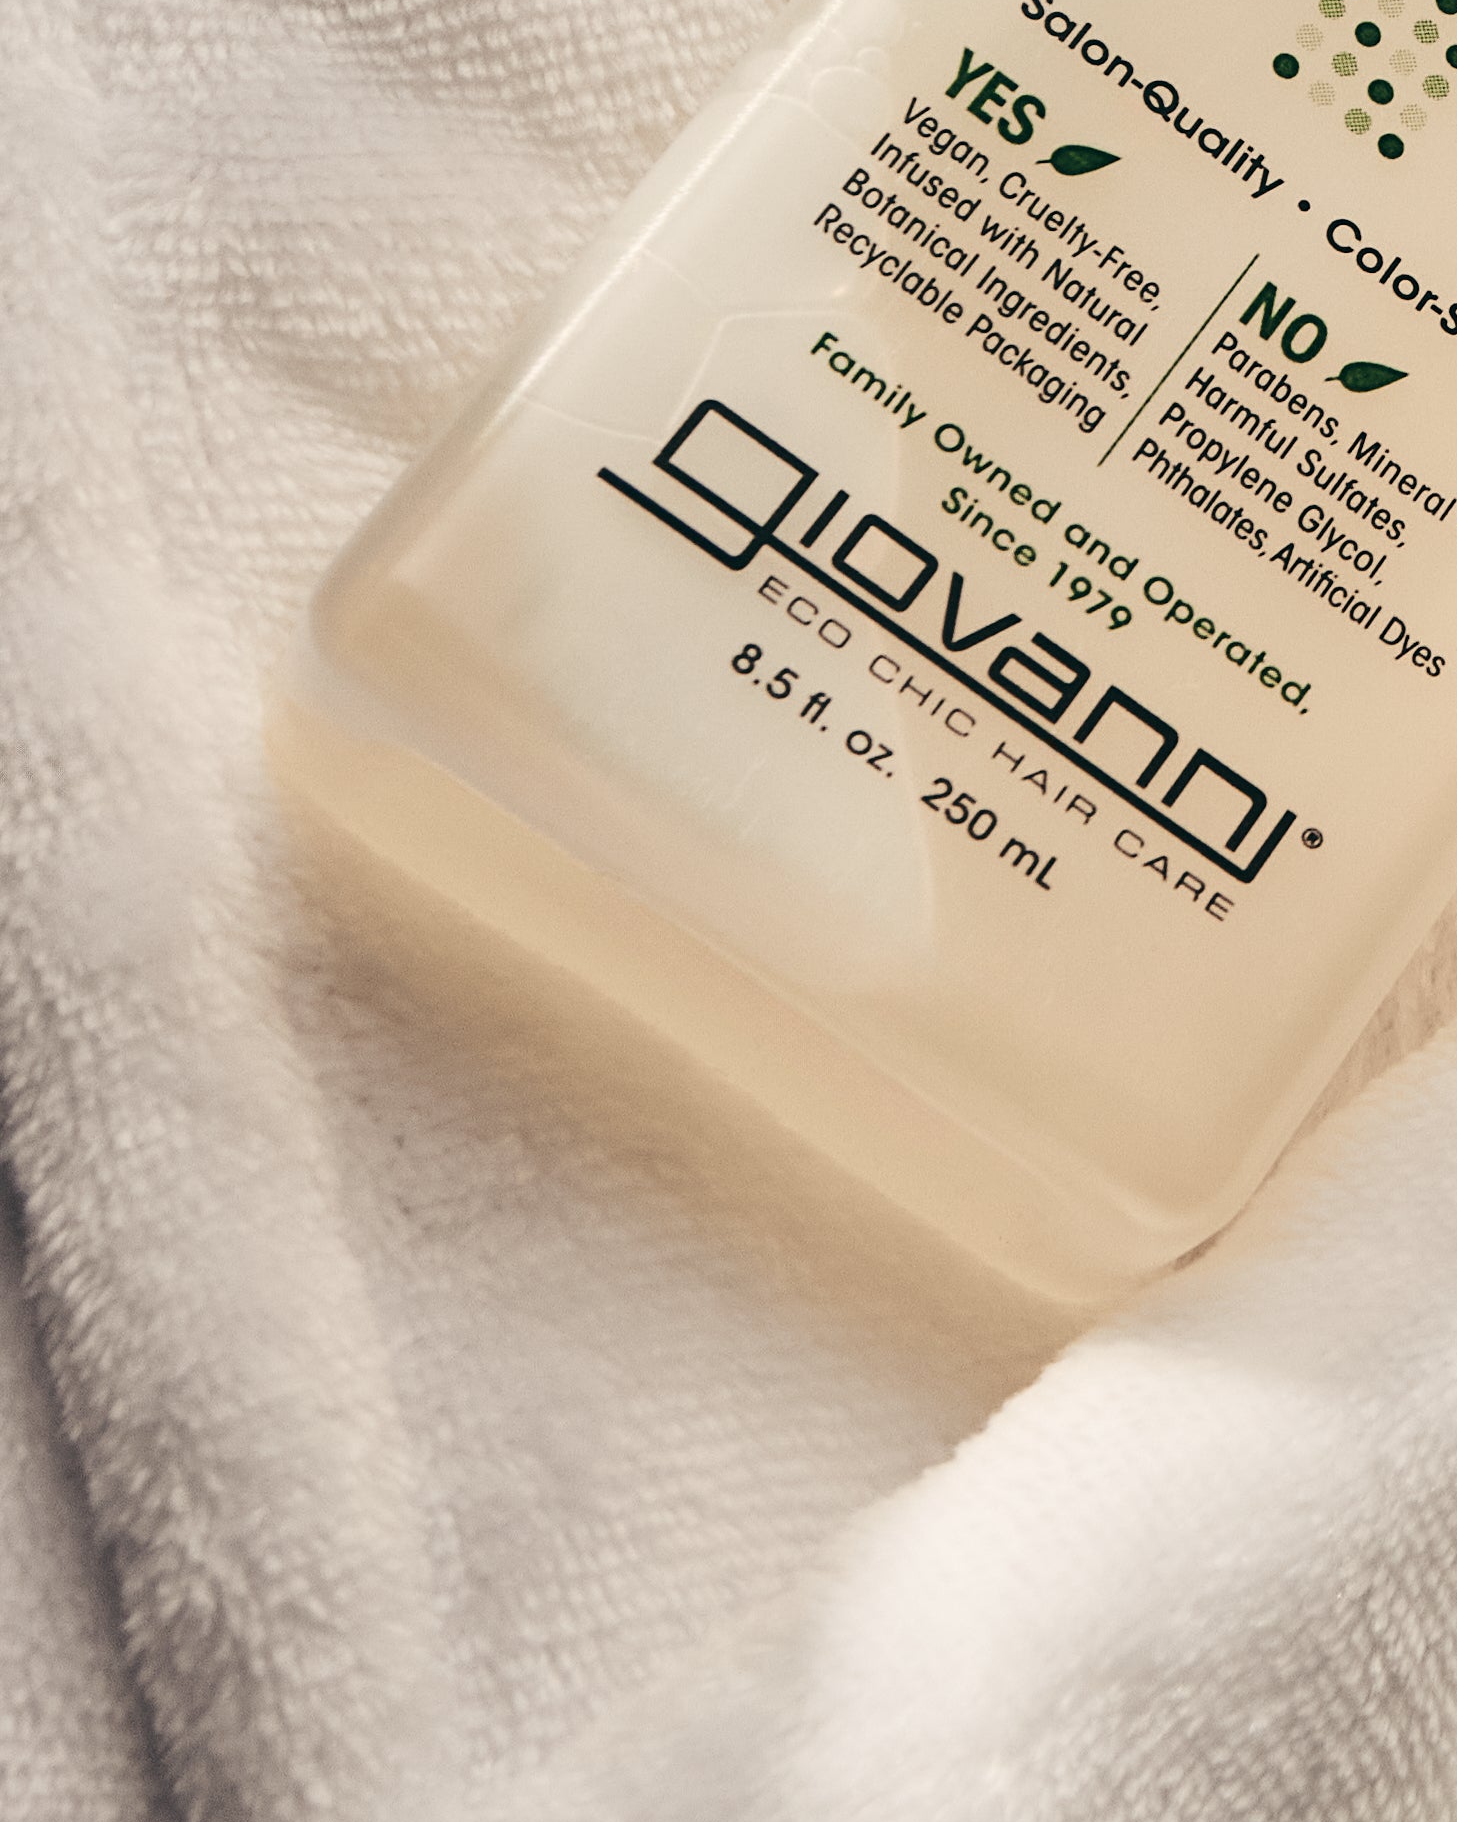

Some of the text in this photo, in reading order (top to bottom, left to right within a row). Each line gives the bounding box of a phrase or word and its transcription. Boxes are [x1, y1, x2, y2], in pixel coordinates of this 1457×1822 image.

[902, 95, 1161, 312] Vegan, Cruelty-Free,
[944, 46, 1047, 146] YES
[812, 202, 1108, 434] Recyclable Packaging
[841, 166, 1132, 400] Botanical Ingredients,
[869, 131, 1149, 348] Infused with Natural
[1237, 280, 1329, 365] NO
[809, 330, 1312, 716] Family Owned and Operated,
[1157, 401, 1388, 588] Propylene Glycol,
[1183, 365, 1406, 549] Harmful Sulfates,
[1210, 330, 1340, 447] Parabens,
[1346, 430, 1457, 523] Mineral
[940, 486, 1133, 632] Since 1979
[1131, 436, 1447, 678] Phthalates, Artificial Dyes
[730, 642, 1059, 892] 8.5 fl. oz. 250 mL
[756, 574, 1235, 922] ECO CHIC HAIR CARE
